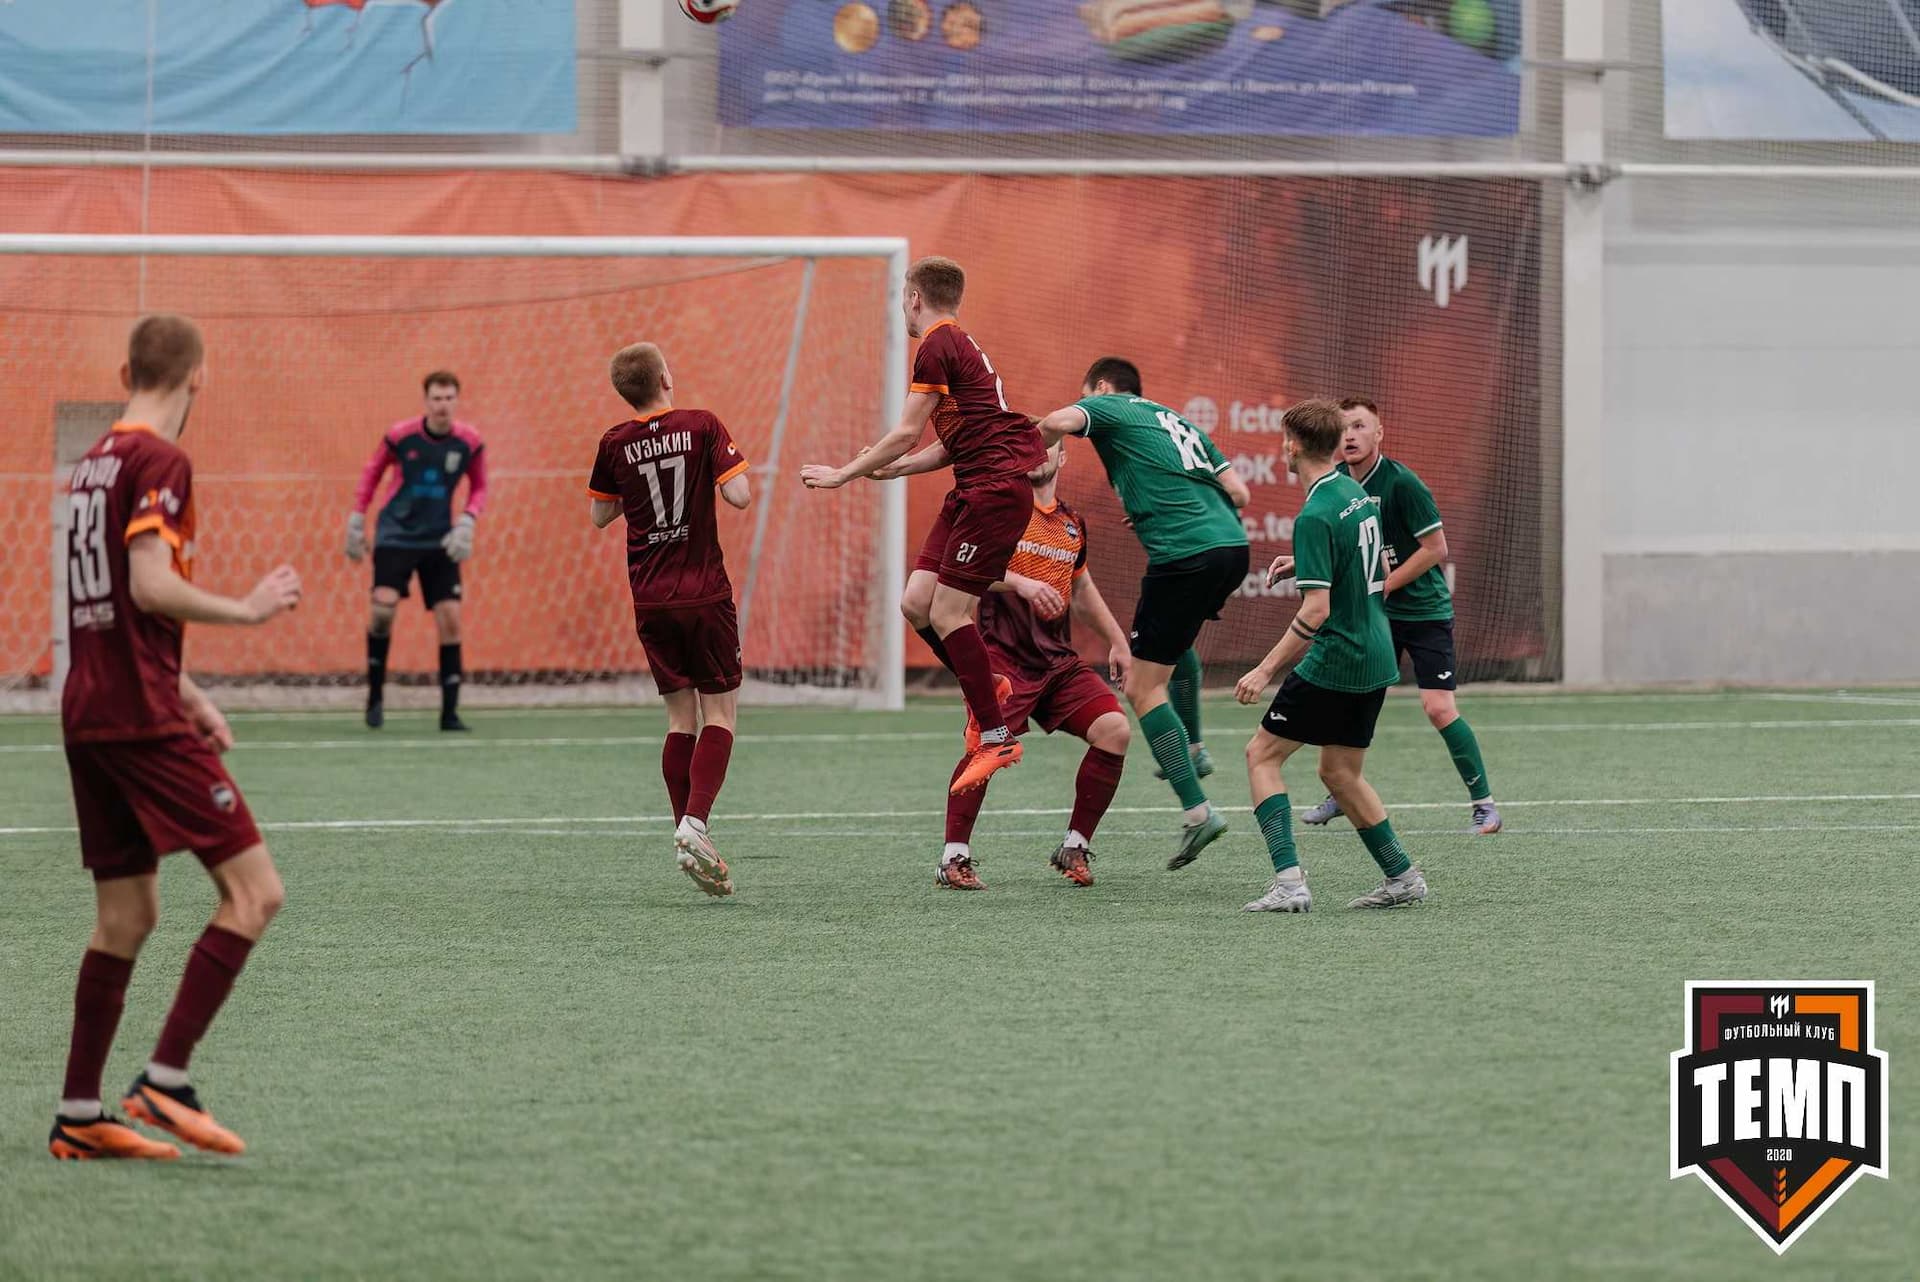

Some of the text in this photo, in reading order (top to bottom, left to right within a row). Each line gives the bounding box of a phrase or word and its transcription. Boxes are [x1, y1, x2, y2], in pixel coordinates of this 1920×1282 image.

[624, 431, 692, 464] КУЗЬКИН
[638, 455, 686, 528] 17
[69, 487, 112, 601] 33
[956, 542, 978, 563] 27
[1358, 515, 1385, 596] 12
